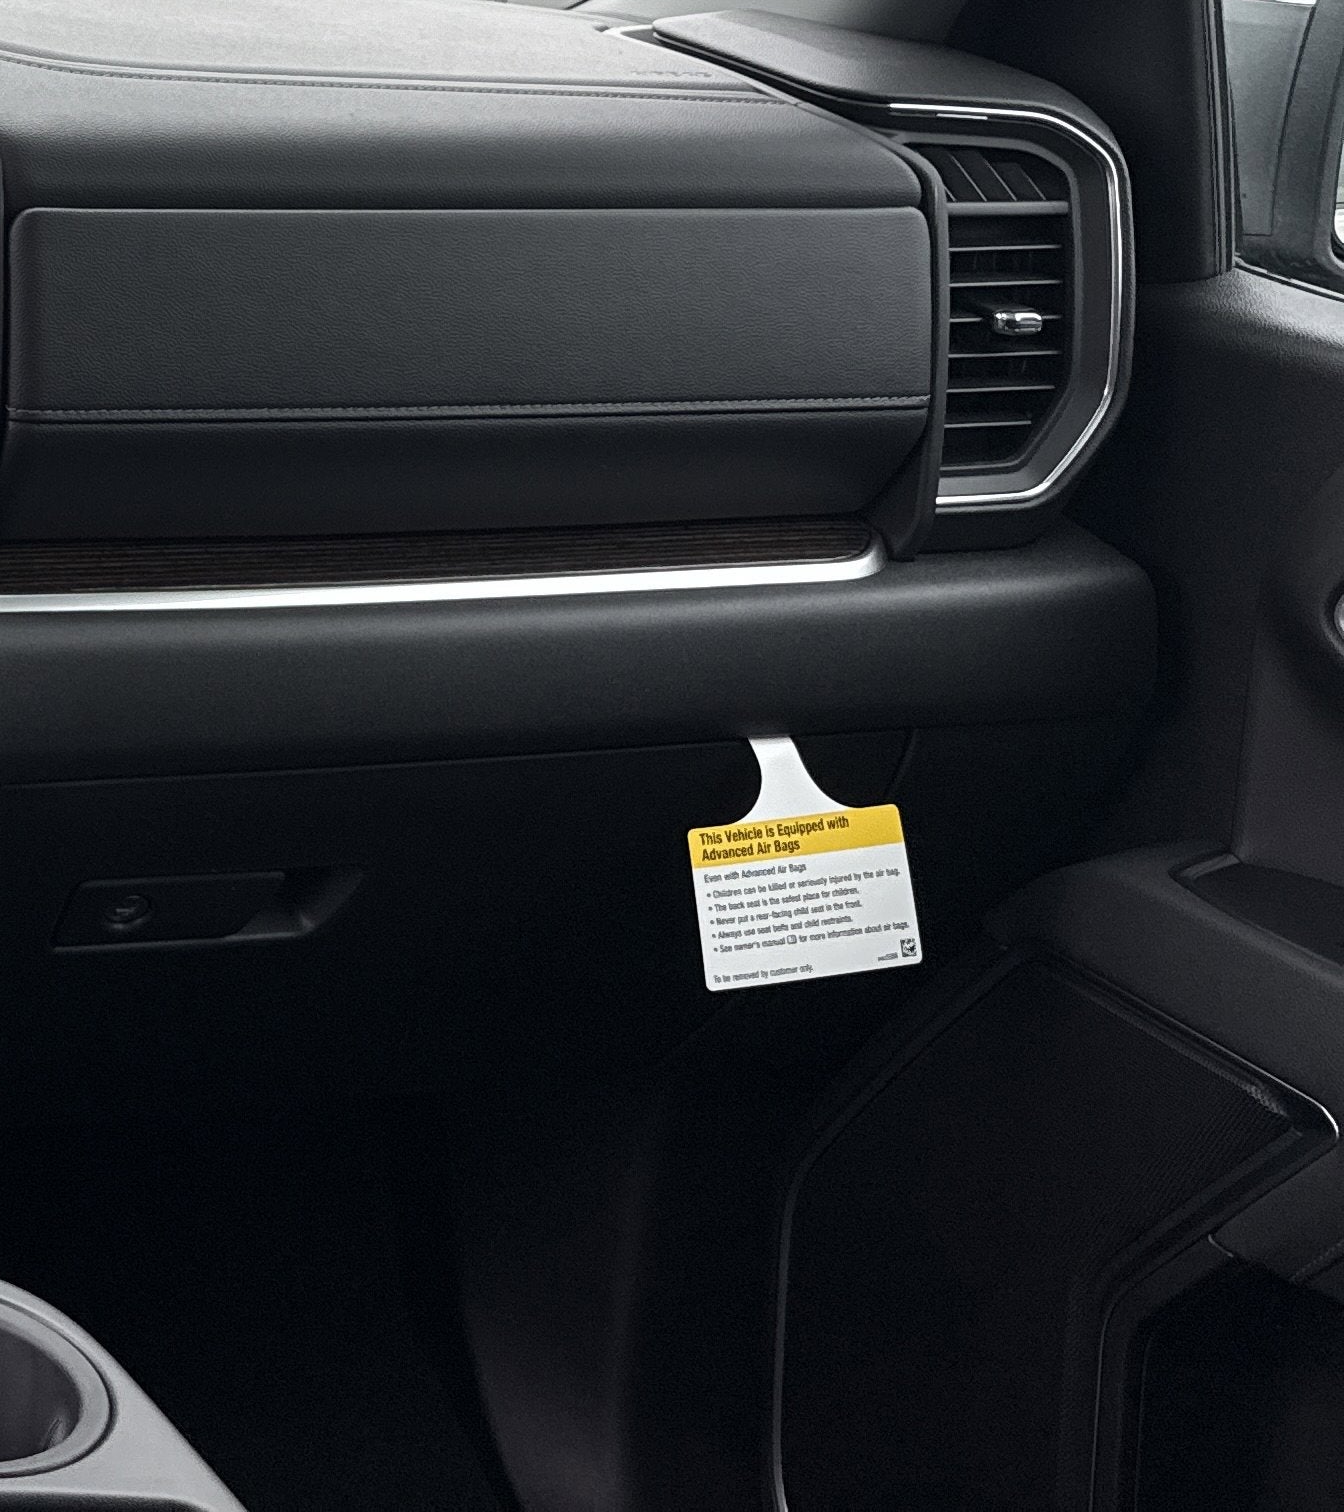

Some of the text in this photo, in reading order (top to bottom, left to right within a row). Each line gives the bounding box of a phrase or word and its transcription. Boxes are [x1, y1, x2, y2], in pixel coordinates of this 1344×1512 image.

[699, 816, 849, 846] This Vehicle is Equipped with
[702, 840, 801, 861] Advanced Air Bags
[704, 864, 807, 883] Even with Advanced Air Bags
[713, 888, 741, 899] Children
[744, 887, 756, 895] can
[758, 885, 766, 893] be
[768, 882, 787, 892] killed
[798, 877, 827, 889] seriously
[829, 873, 852, 884] injured
[853, 872, 861, 882] by
[863, 871, 874, 879] the
[876, 869, 885, 877] air
[886, 868, 900, 877] bag.
[714, 903, 727, 912] The
[728, 901, 745, 911] back
[769, 897, 780, 905] the
[738, 915, 748, 925] put
[718, 930, 742, 940] Always
[720, 944, 733, 953] See
[713, 975, 721, 984] To
[722, 975, 731, 983] be
[761, 970, 769, 978] by
